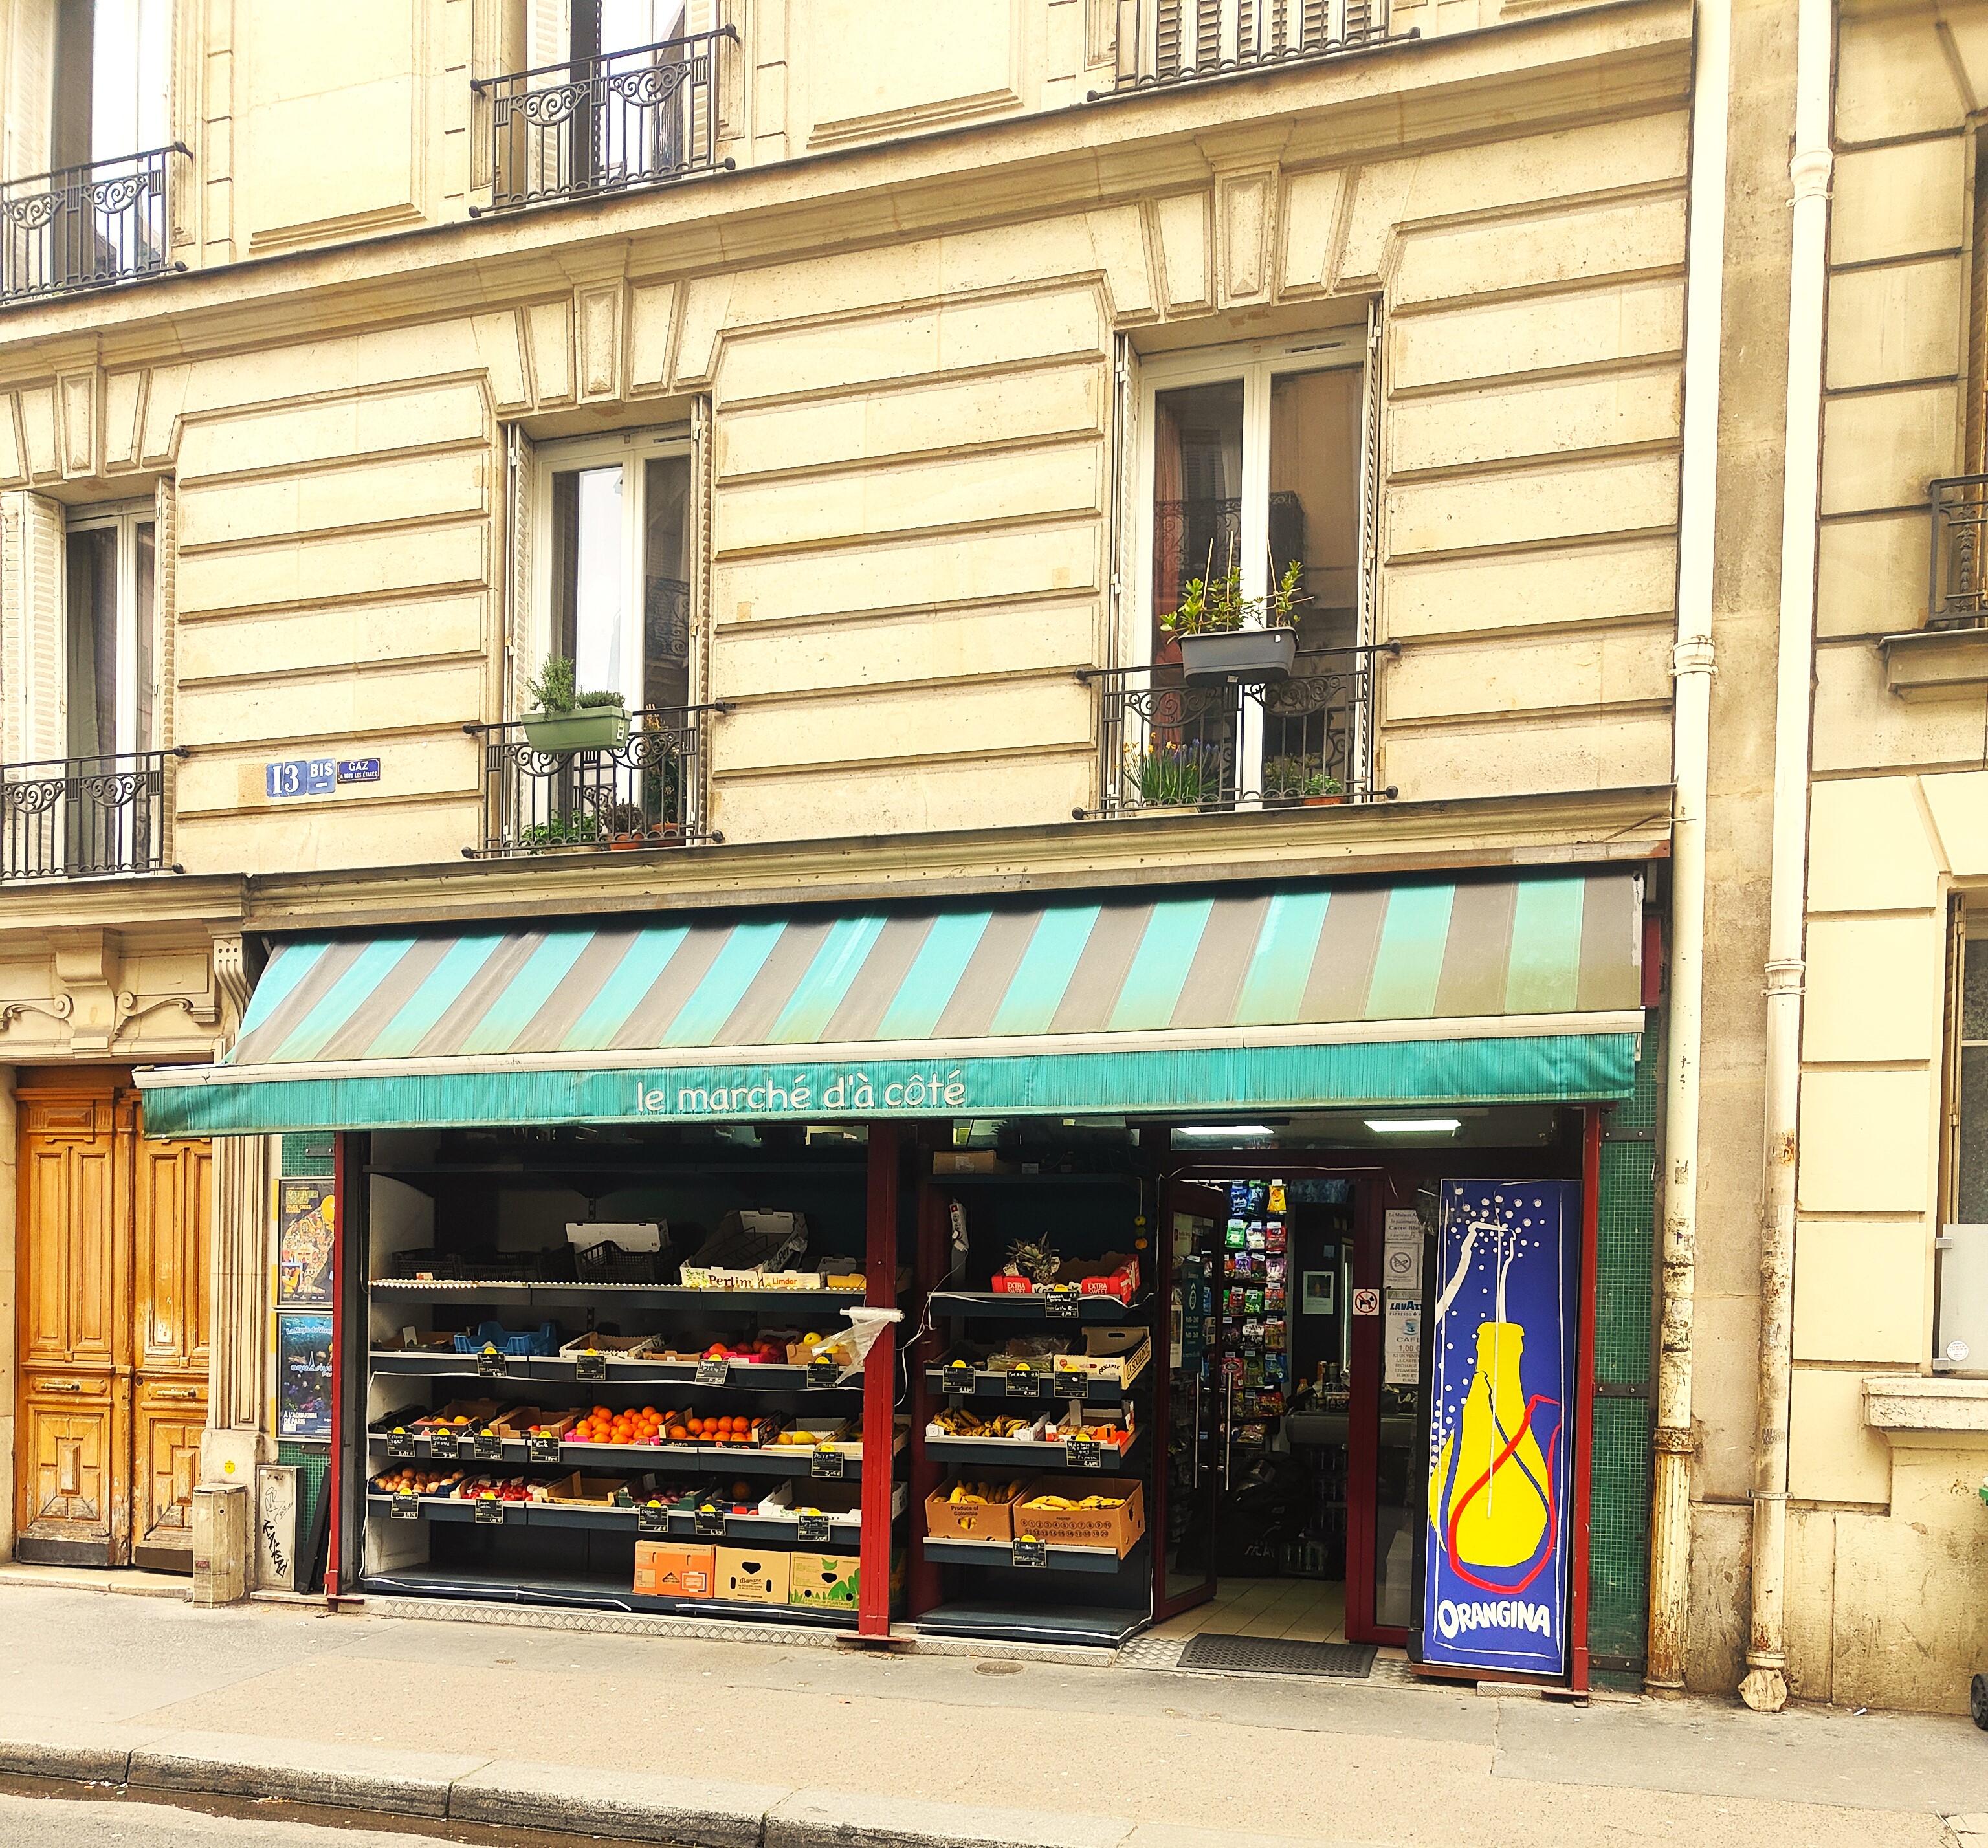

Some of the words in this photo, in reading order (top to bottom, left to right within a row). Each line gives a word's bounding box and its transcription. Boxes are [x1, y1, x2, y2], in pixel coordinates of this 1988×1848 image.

[349, 761, 369, 771] GAZ
[272, 765, 299, 794] 13
[310, 763, 333, 778] BIS
[637, 1081, 665, 1112] le
[678, 1074, 812, 1112] marché
[823, 1071, 876, 1110] d'à
[884, 1068, 966, 1106] côté
[708, 1275, 752, 1287] Perlim
[294, 1326, 309, 1335] Magie
[1398, 1345, 1414, 1353] 1,00
[1437, 1600, 1551, 1639] ORANGINA
